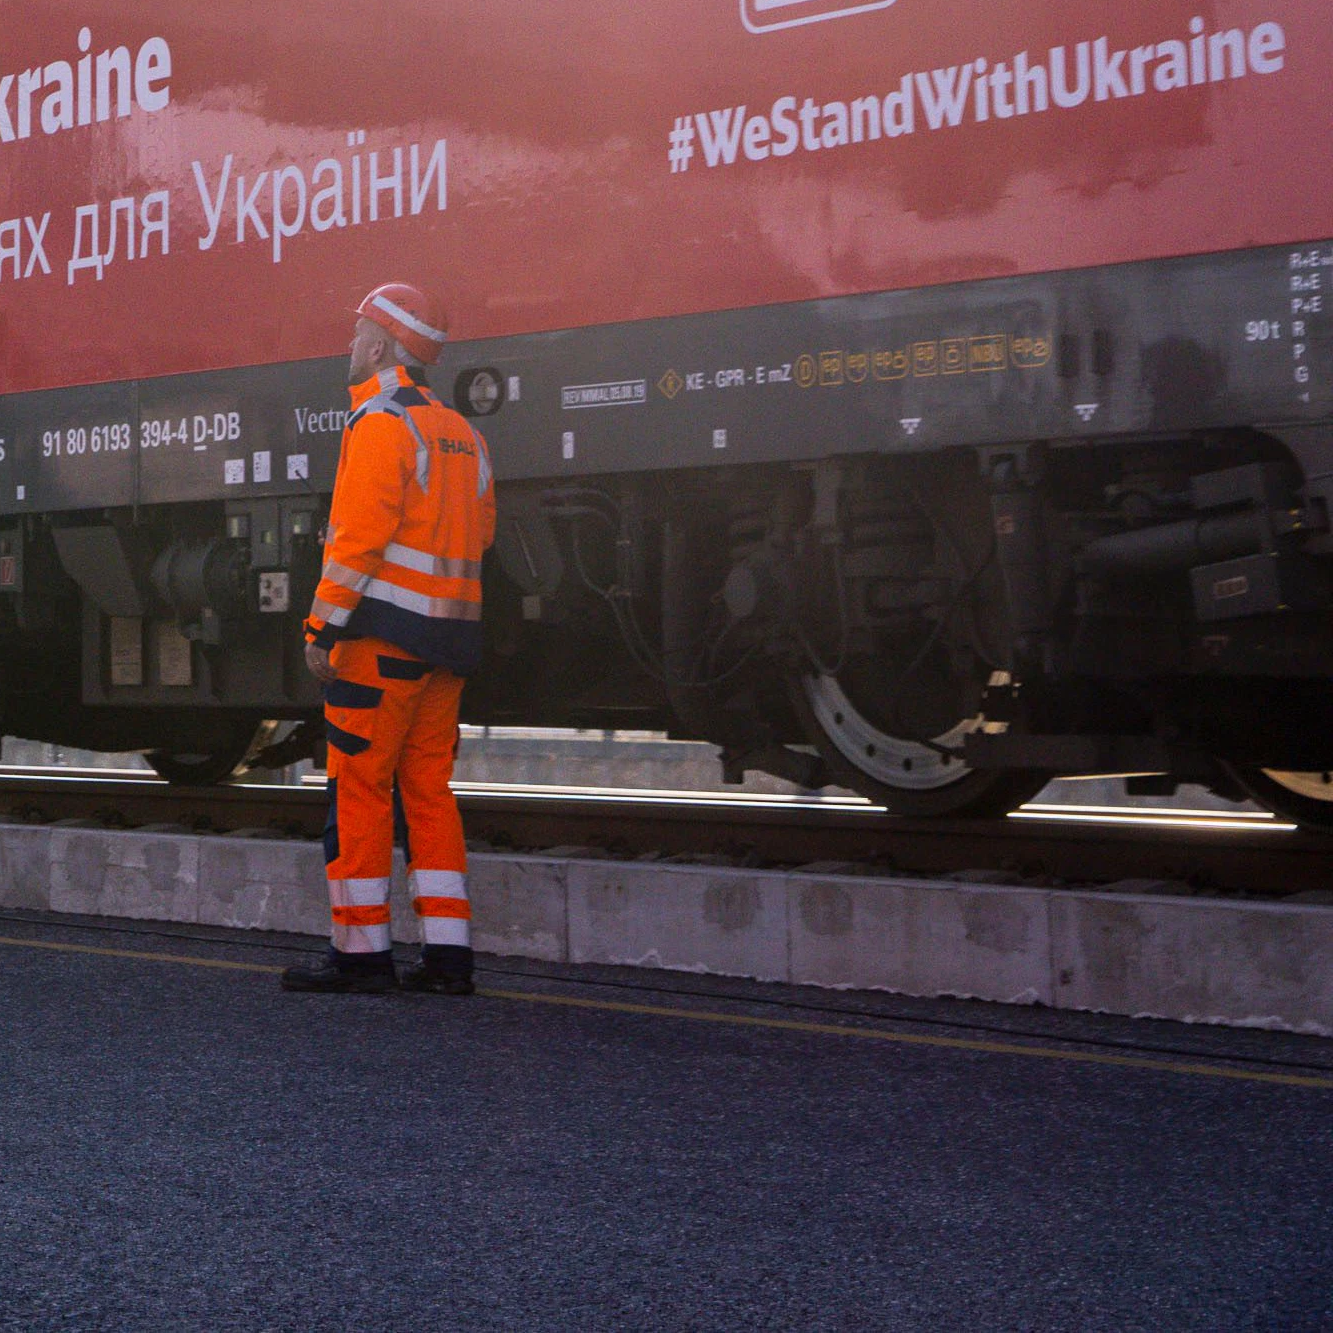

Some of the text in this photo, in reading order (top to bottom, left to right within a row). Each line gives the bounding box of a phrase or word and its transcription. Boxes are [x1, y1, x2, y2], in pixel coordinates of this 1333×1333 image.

[668, 15, 1286, 173] #WeStandWithUkraine
[67, 189, 171, 286] для
[191, 129, 449, 264] України
[42, 411, 242, 457] 91 80 6193 394-4 D-DB
